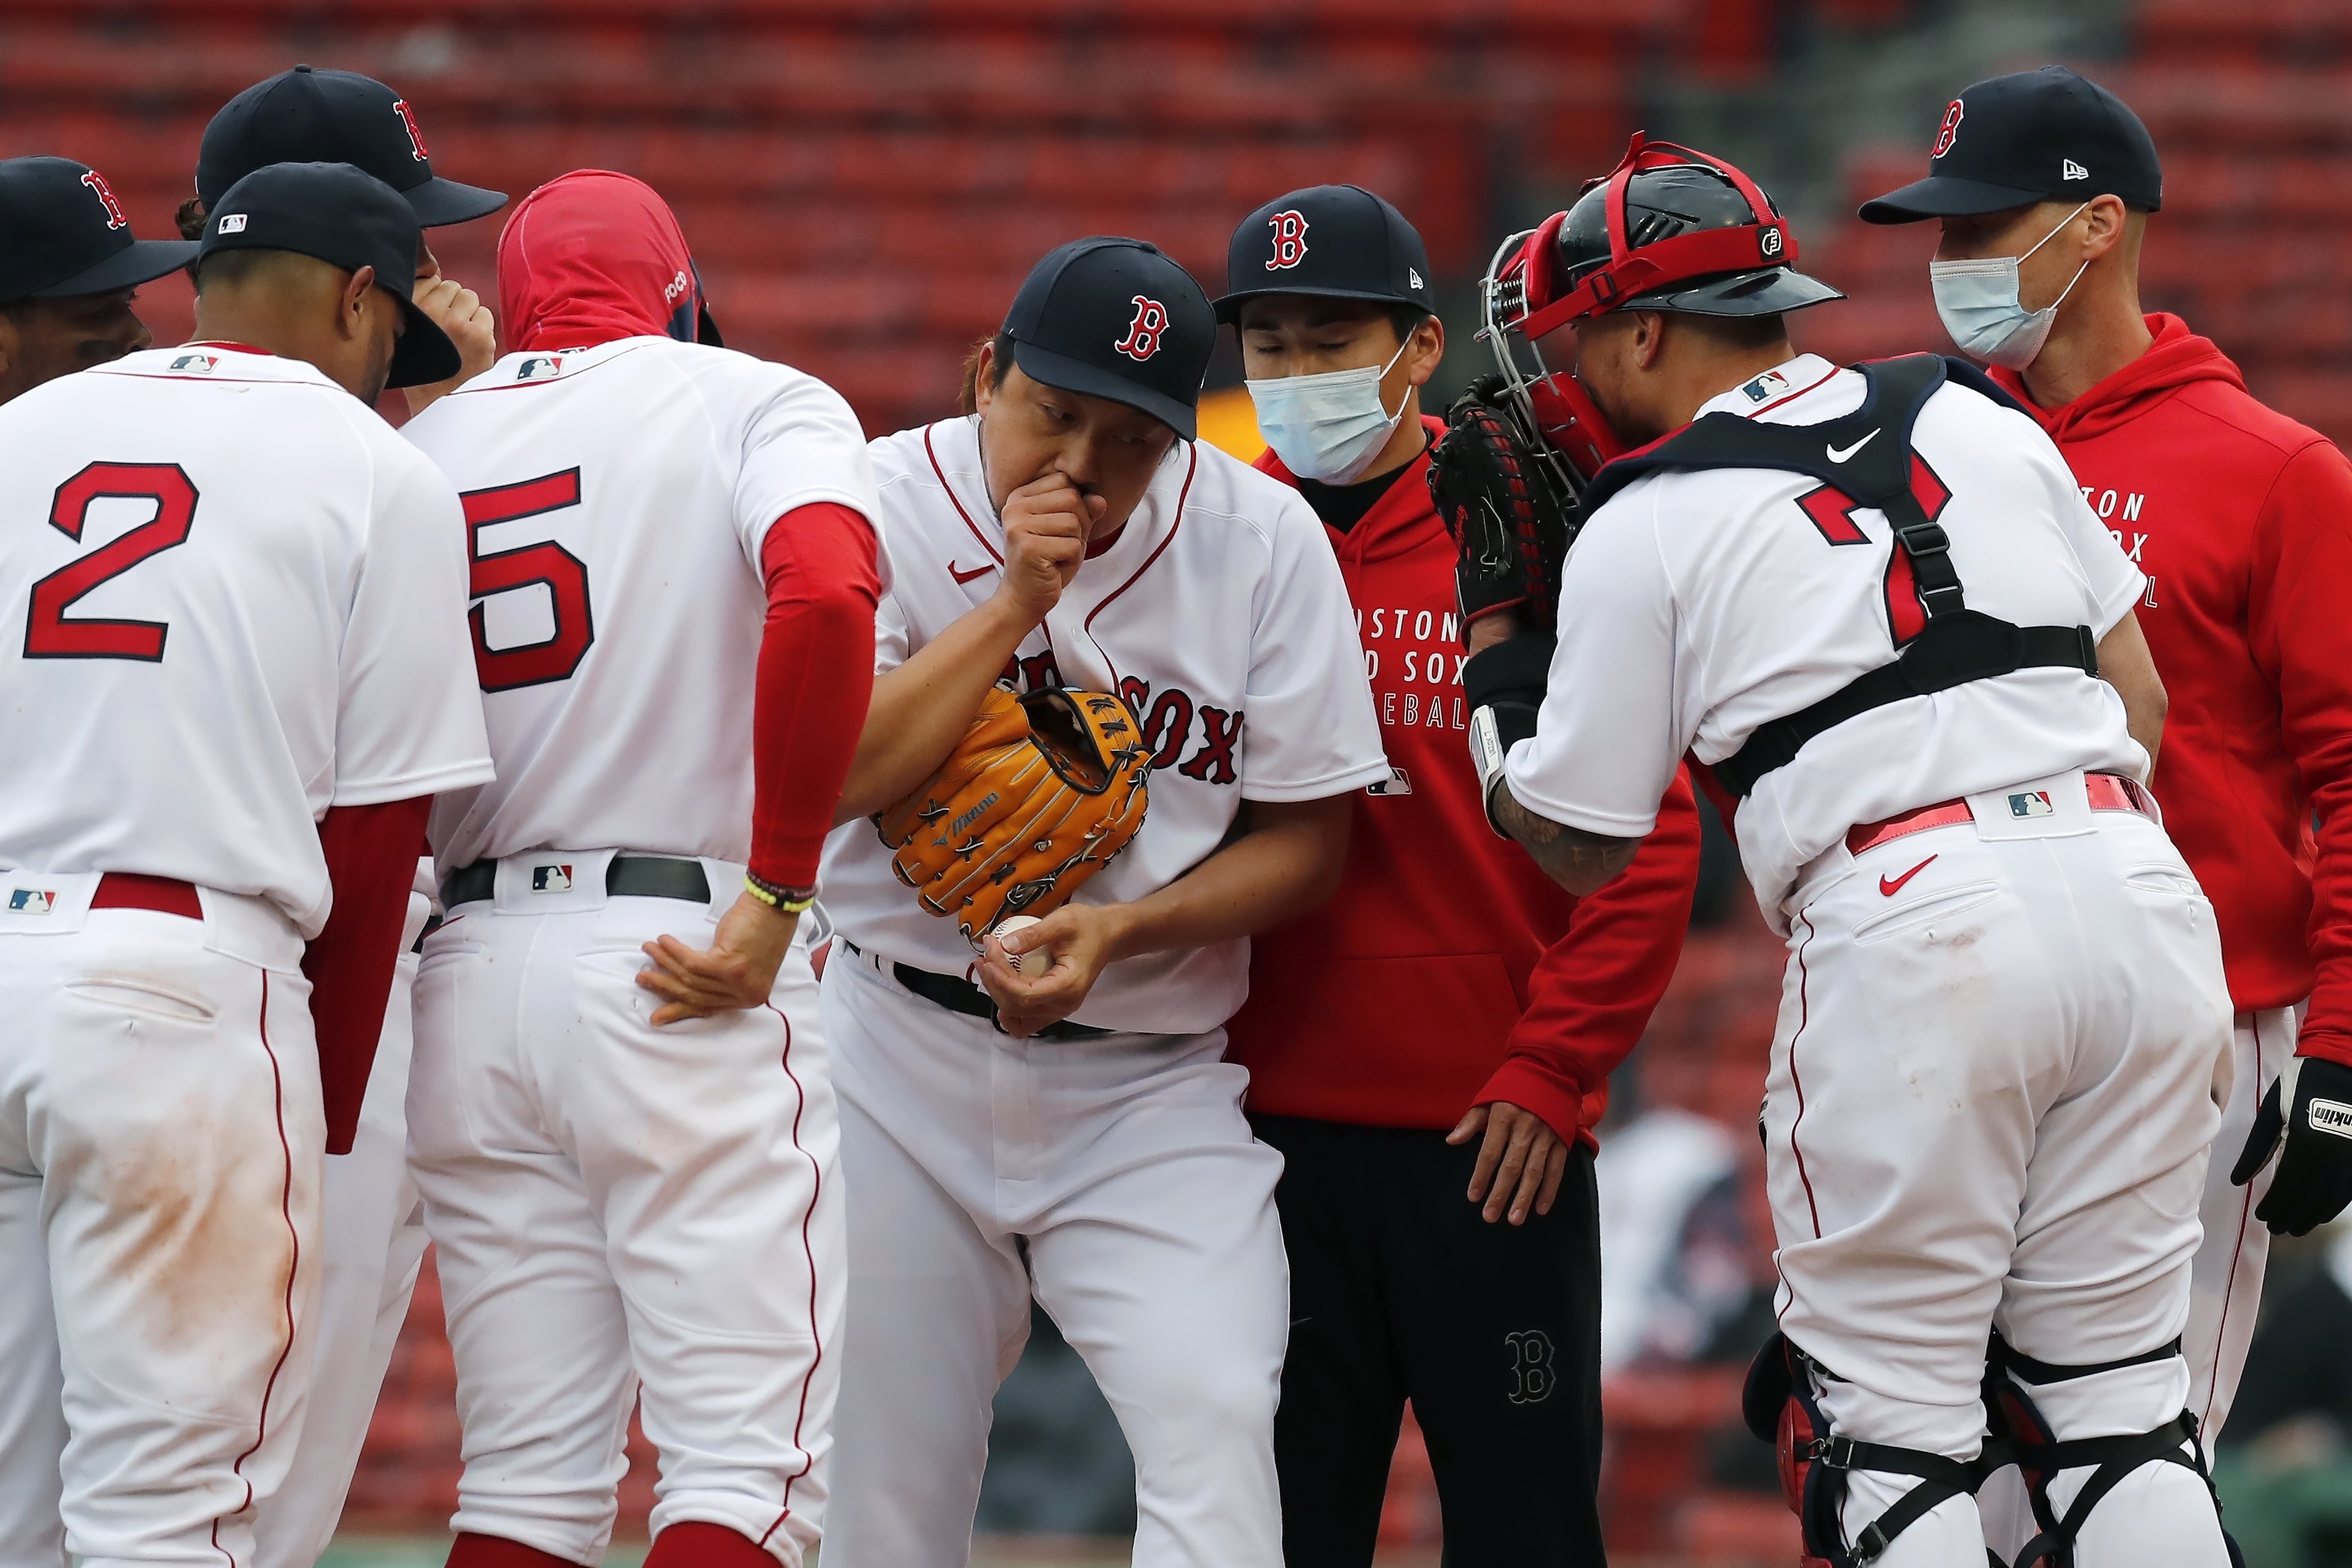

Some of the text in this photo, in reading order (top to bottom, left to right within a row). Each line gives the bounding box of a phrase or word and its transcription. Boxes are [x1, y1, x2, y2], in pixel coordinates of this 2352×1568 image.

[1930, 99, 1964, 160] B
[1265, 210, 1310, 271] B
[1114, 295, 1170, 362] B
[23, 461, 200, 662] 2
[458, 466, 594, 694] 5
[1404, 651, 1470, 686] SOX
[1504, 1329, 1557, 1404] B
